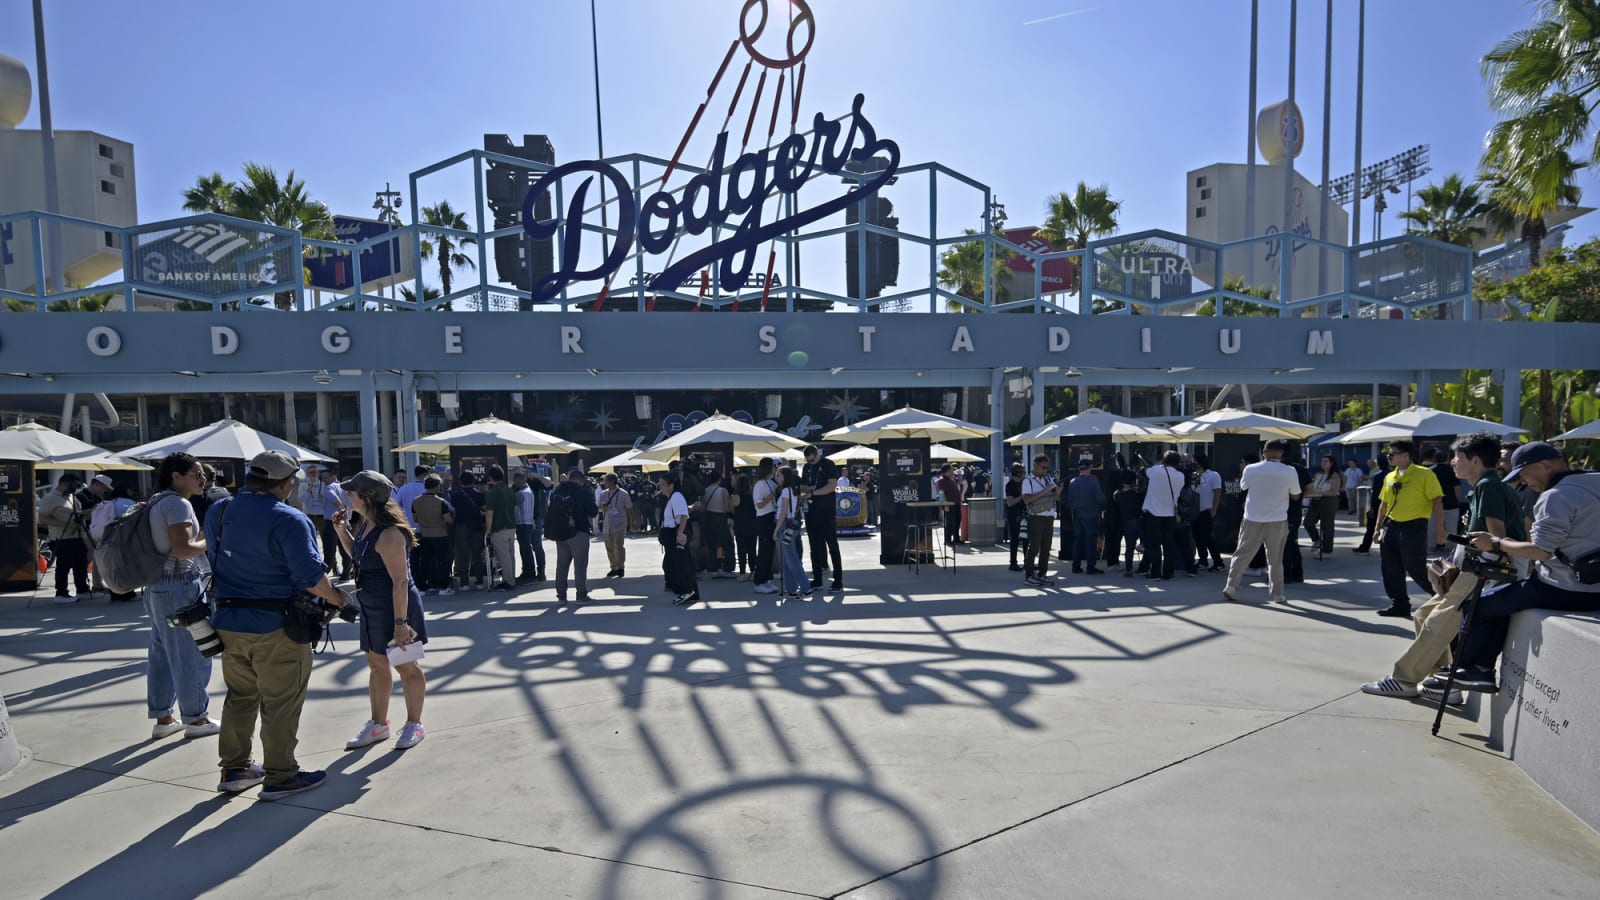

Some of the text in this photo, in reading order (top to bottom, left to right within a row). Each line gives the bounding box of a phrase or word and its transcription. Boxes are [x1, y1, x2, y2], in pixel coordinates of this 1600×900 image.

[523, 93, 901, 304] Dodgers
[158, 272, 266, 281] BANK OF AMERIC
[1121, 257, 1194, 274] ULTRA
[758, 325, 1335, 355] STADIUM
[1535, 679, 1561, 704] except
[1524, 698, 1543, 720] other
